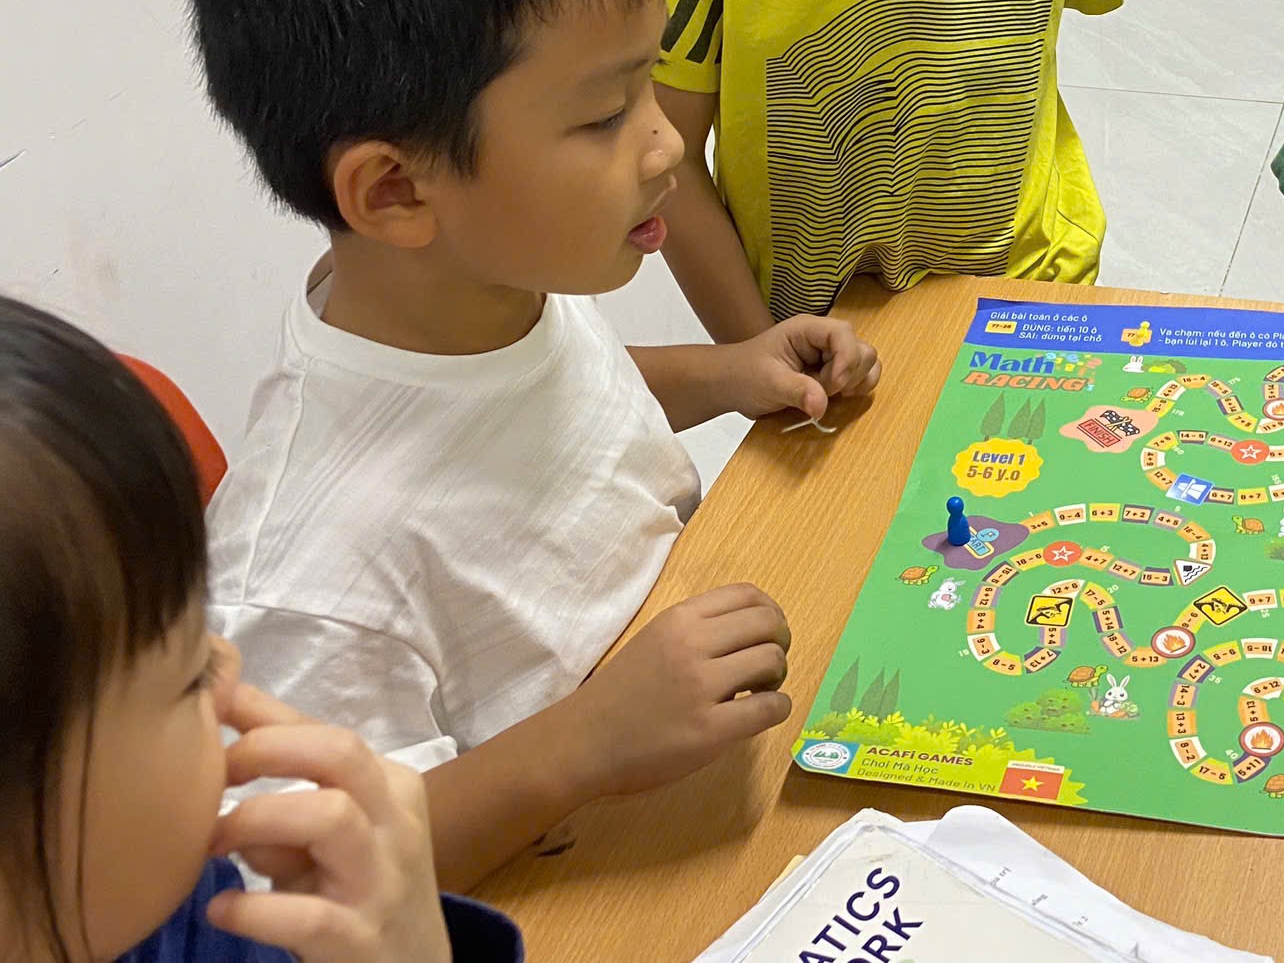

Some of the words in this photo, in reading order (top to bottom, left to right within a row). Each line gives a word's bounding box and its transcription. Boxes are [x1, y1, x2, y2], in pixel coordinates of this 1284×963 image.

[1079, 326, 1089, 334] 10
[1160, 328, 1173, 337] Va
[1232, 339, 1263, 350] Player
[970, 351, 1054, 374] Math
[963, 371, 1087, 391] RACING
[1084, 420, 1118, 445] FINISH
[972, 450, 1013, 464] Level
[967, 465, 993, 479] 5-6
[995, 469, 1021, 481] y.o
[867, 747, 916, 761] ACAFi
[918, 752, 974, 767] GAMES
[856, 768, 912, 783] Designed
[928, 777, 960, 789] Made
[979, 781, 996, 793] VN
[847, 906, 924, 963] RK
